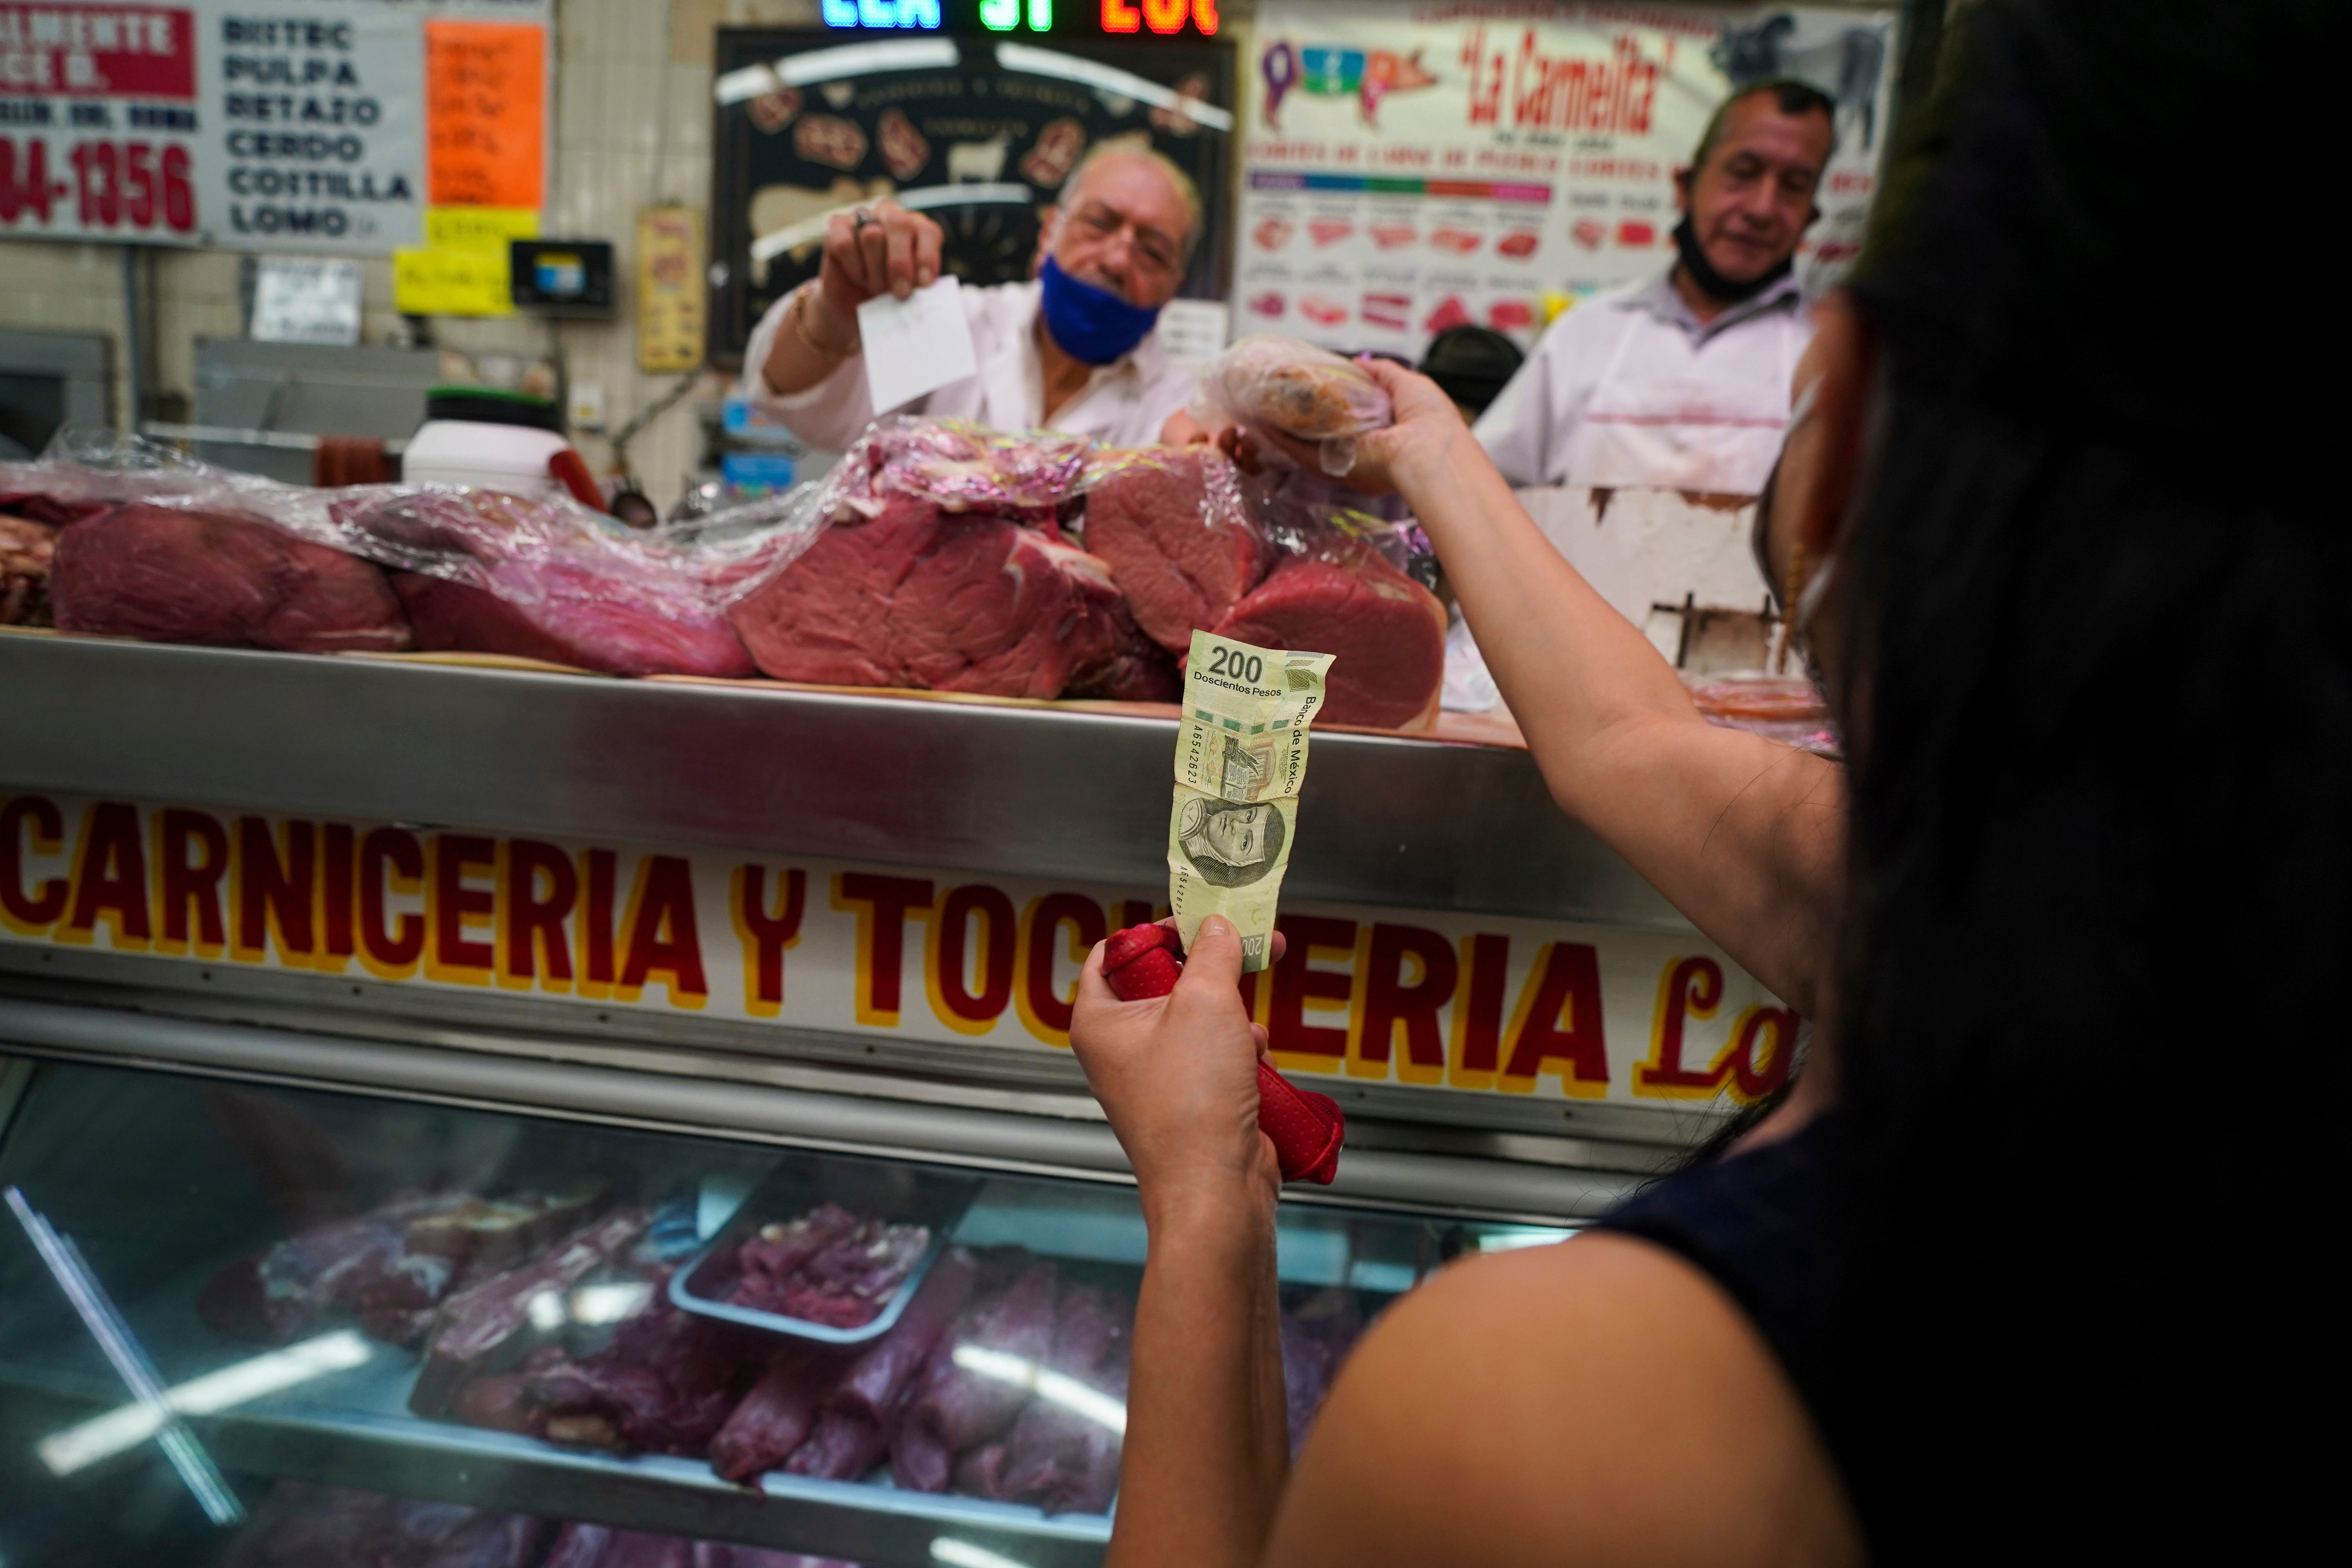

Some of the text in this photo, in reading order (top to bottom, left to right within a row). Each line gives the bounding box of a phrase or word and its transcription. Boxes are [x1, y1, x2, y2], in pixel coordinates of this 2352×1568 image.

[1194, 671, 1250, 694] Doscientos
[1208, 645, 1263, 684] 200
[1252, 687, 1281, 697] Pesos
[1188, 725, 1203, 784] A6542623
[1285, 697, 1317, 794] Banco de México
[0, 794, 708, 1011] CARNICERIA
[731, 862, 807, 1018] Y
[830, 872, 1610, 1101] TOCERIA
